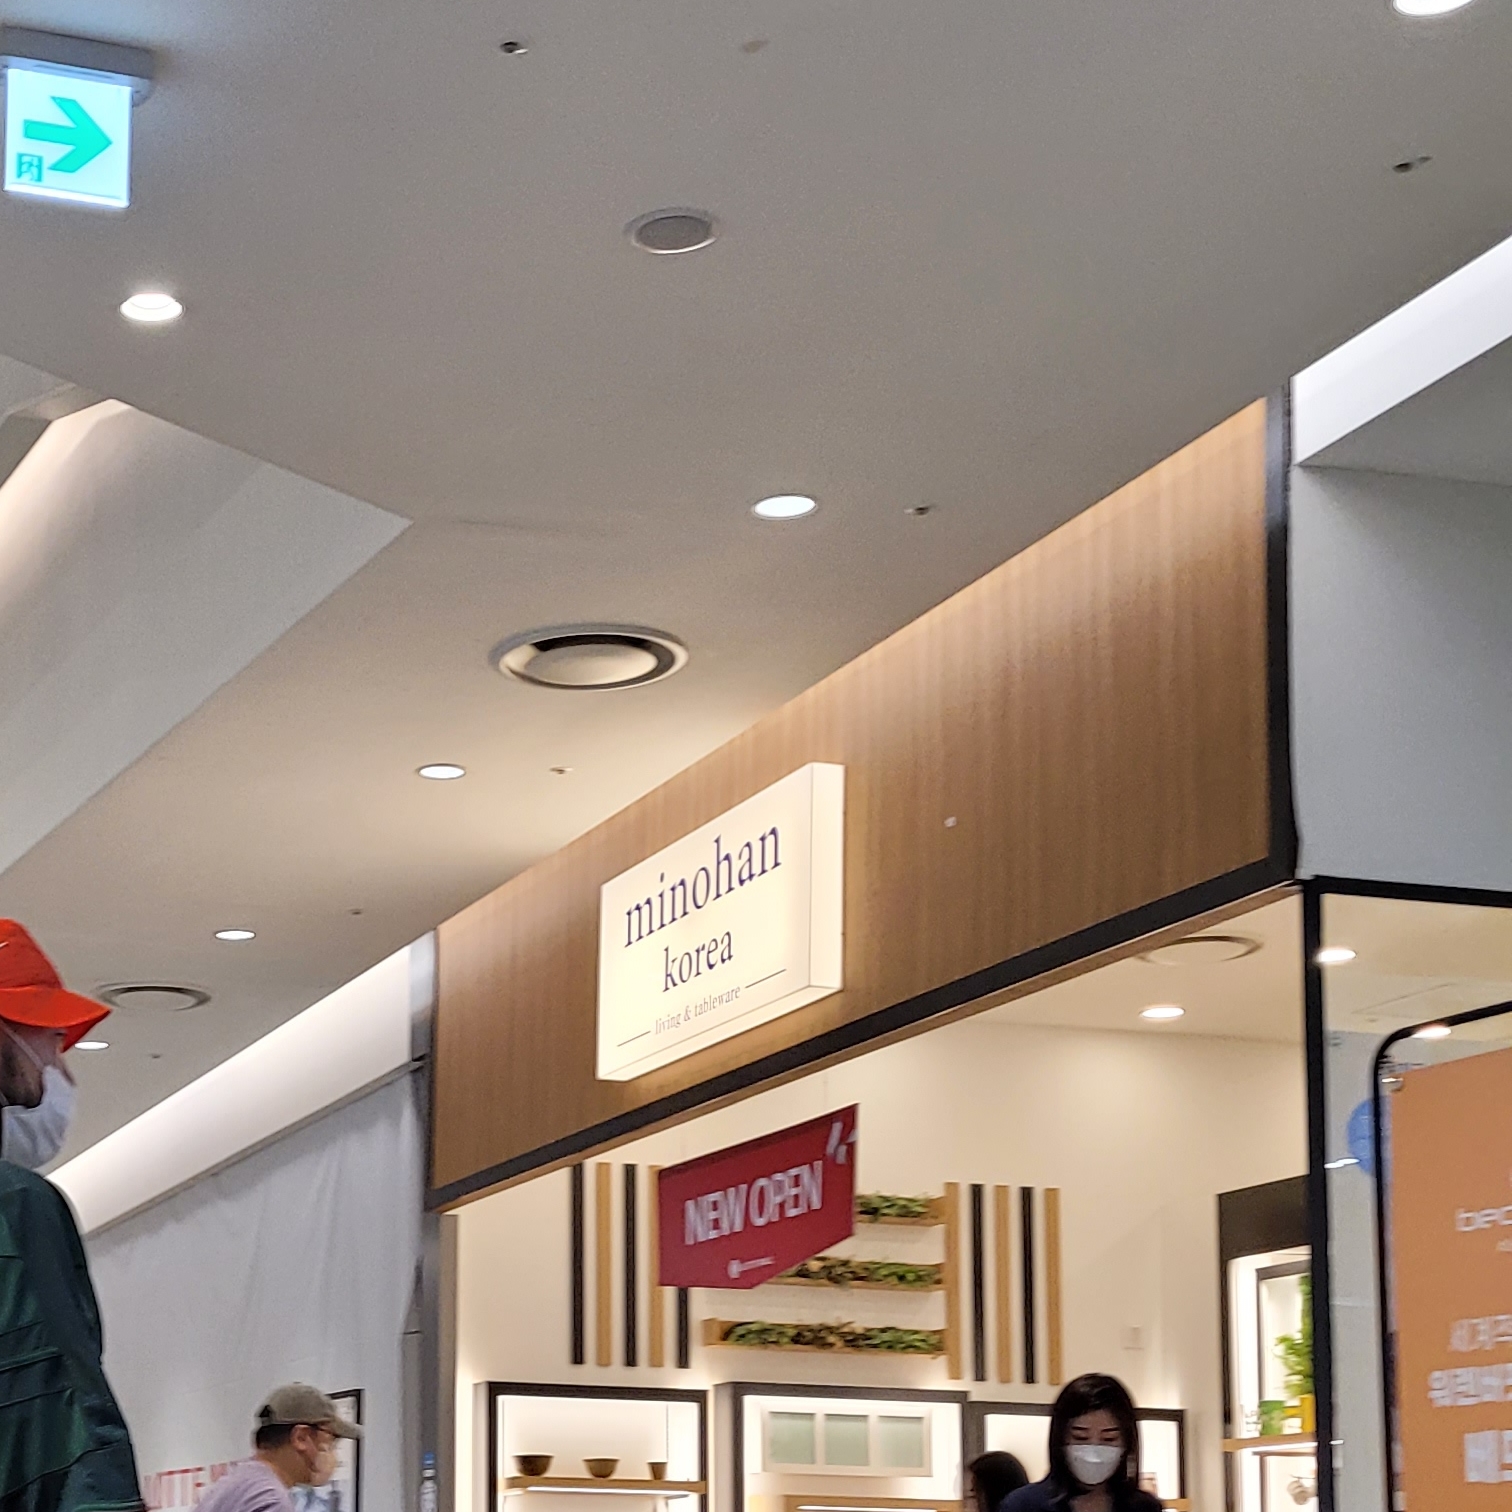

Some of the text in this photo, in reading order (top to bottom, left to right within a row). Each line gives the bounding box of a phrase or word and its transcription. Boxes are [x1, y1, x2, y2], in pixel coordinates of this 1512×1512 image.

[622, 823, 783, 950] minohan
[661, 927, 735, 994] korea
[654, 986, 741, 1036] living & tableware
[683, 1158, 825, 1247] NEW OPEN
